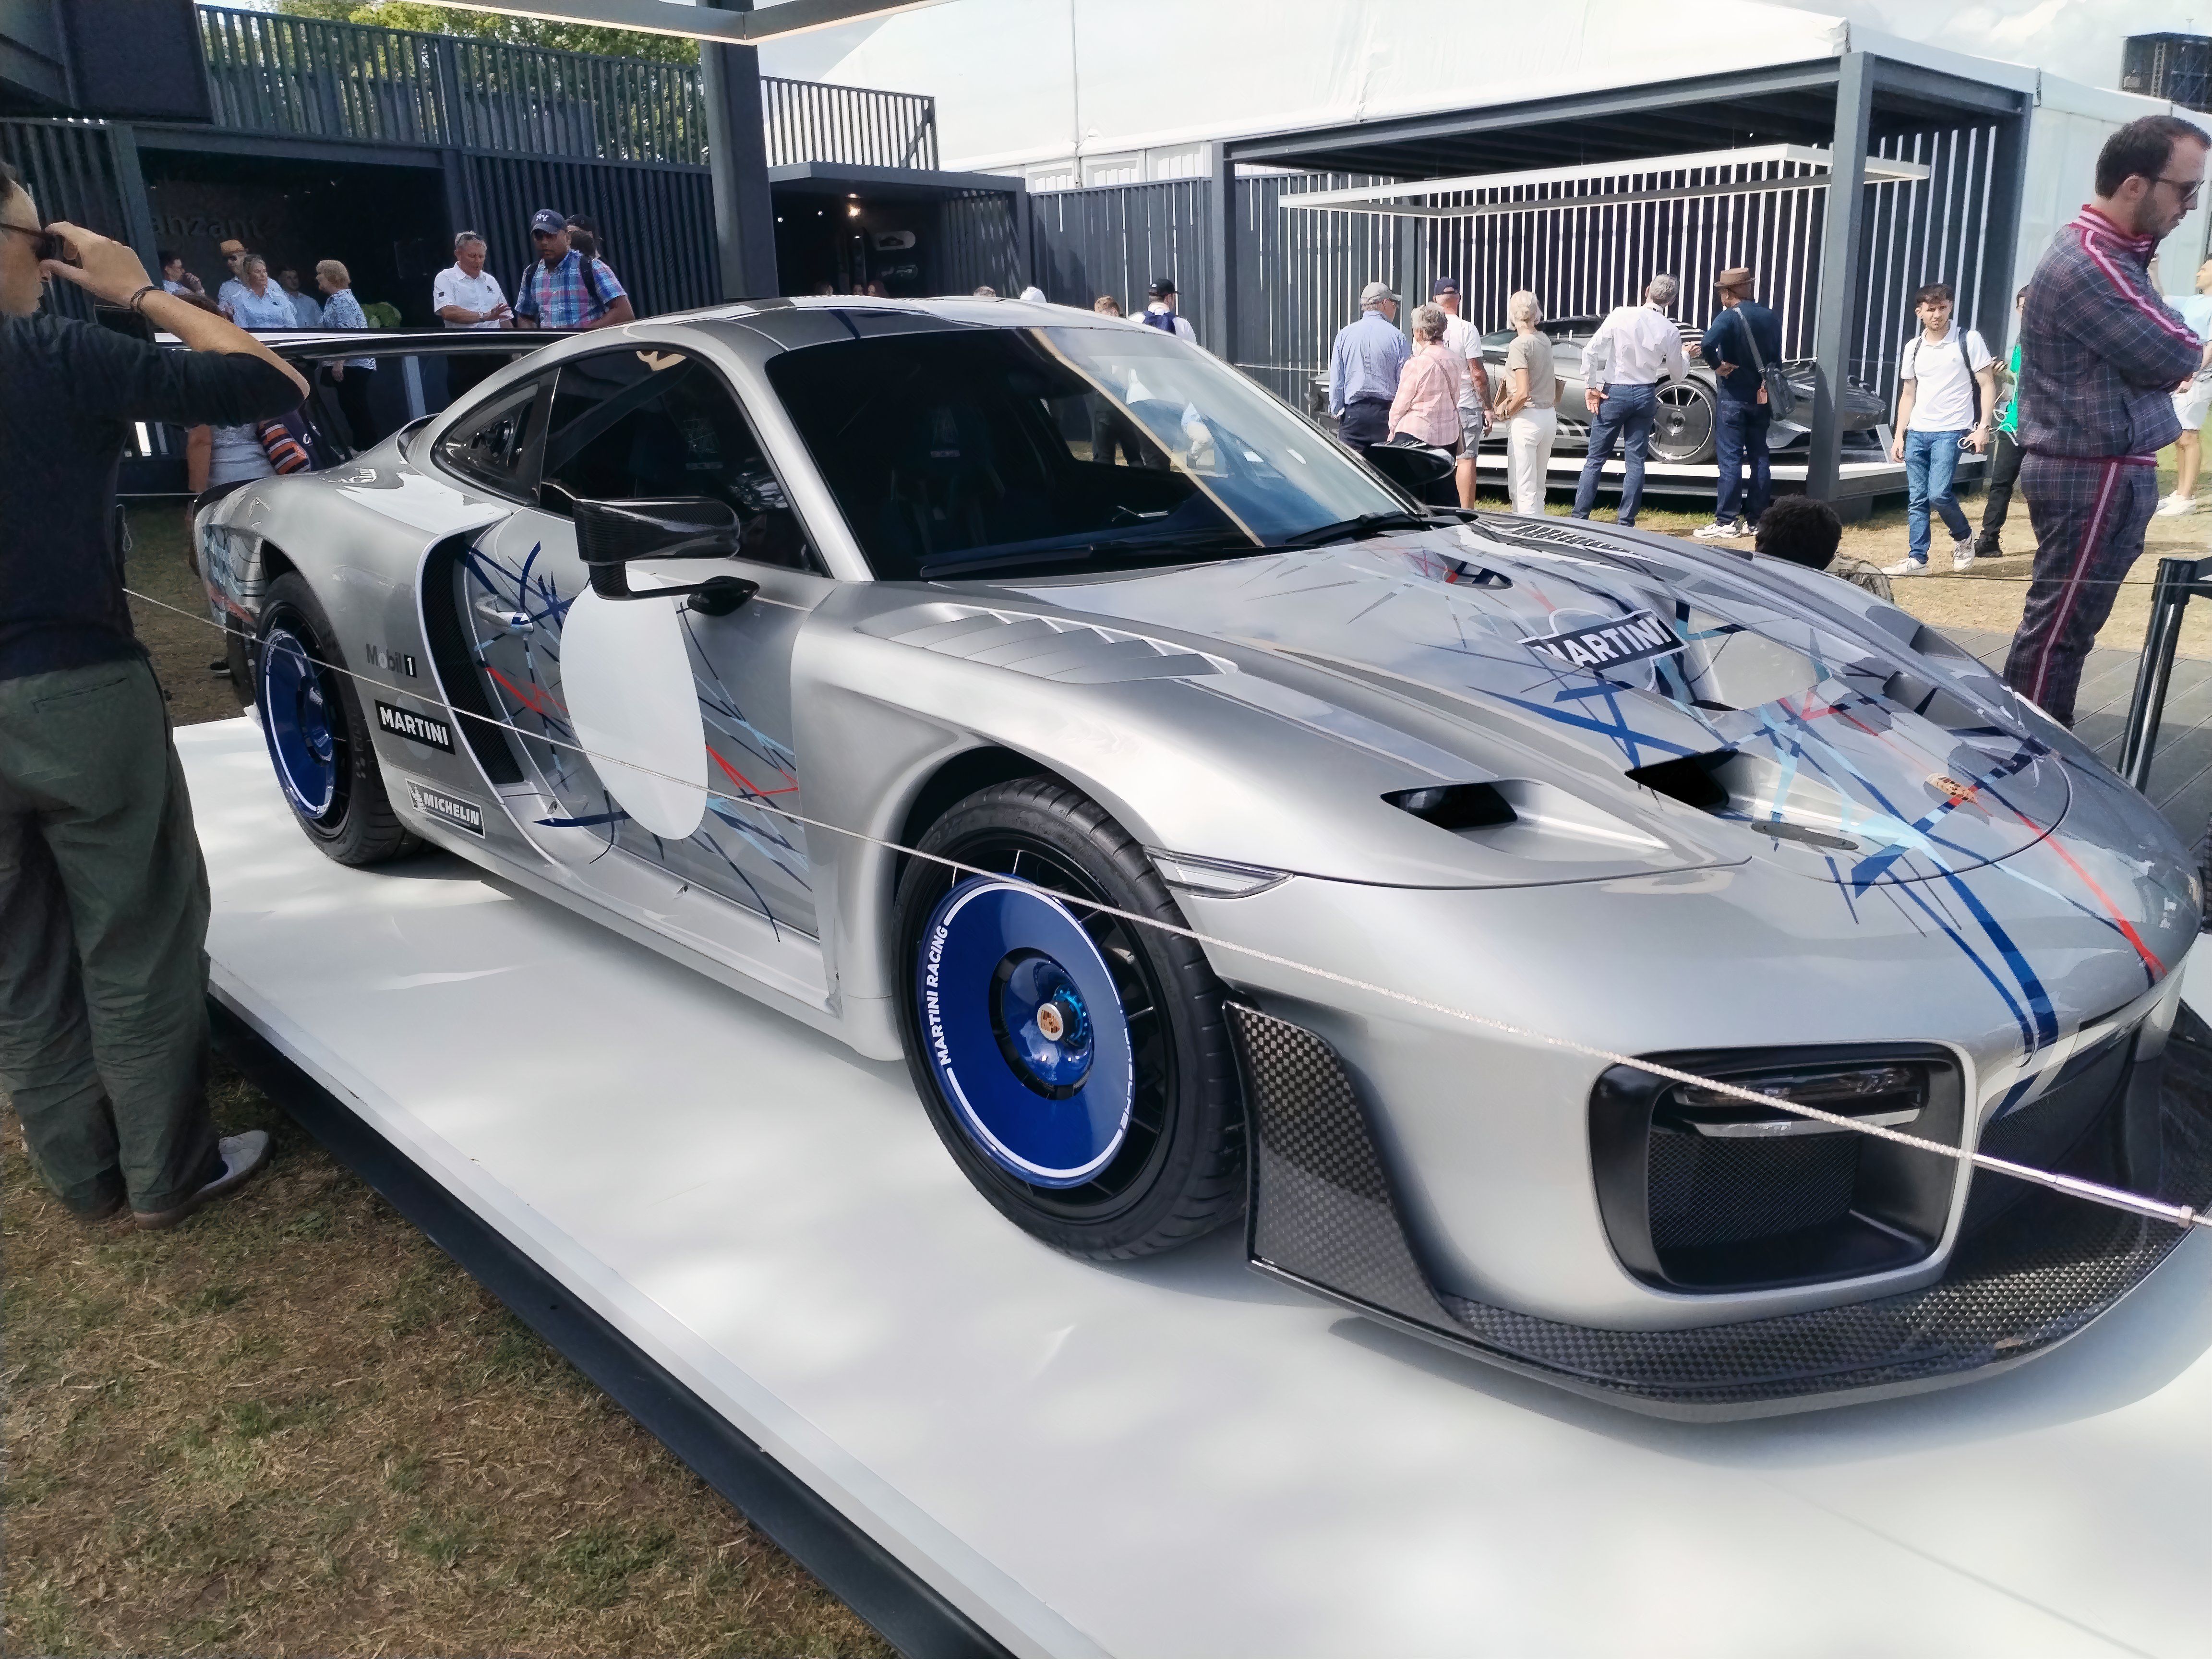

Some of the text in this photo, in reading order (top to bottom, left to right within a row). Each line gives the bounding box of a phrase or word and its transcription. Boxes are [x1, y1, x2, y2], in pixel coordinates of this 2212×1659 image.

[535, 213, 549, 221] NY
[366, 643, 403, 674] Mobil
[380, 706, 449, 746] MARTINI
[423, 792, 479, 826] MICHELIN
[926, 925, 951, 1066] MARTINI RACING
